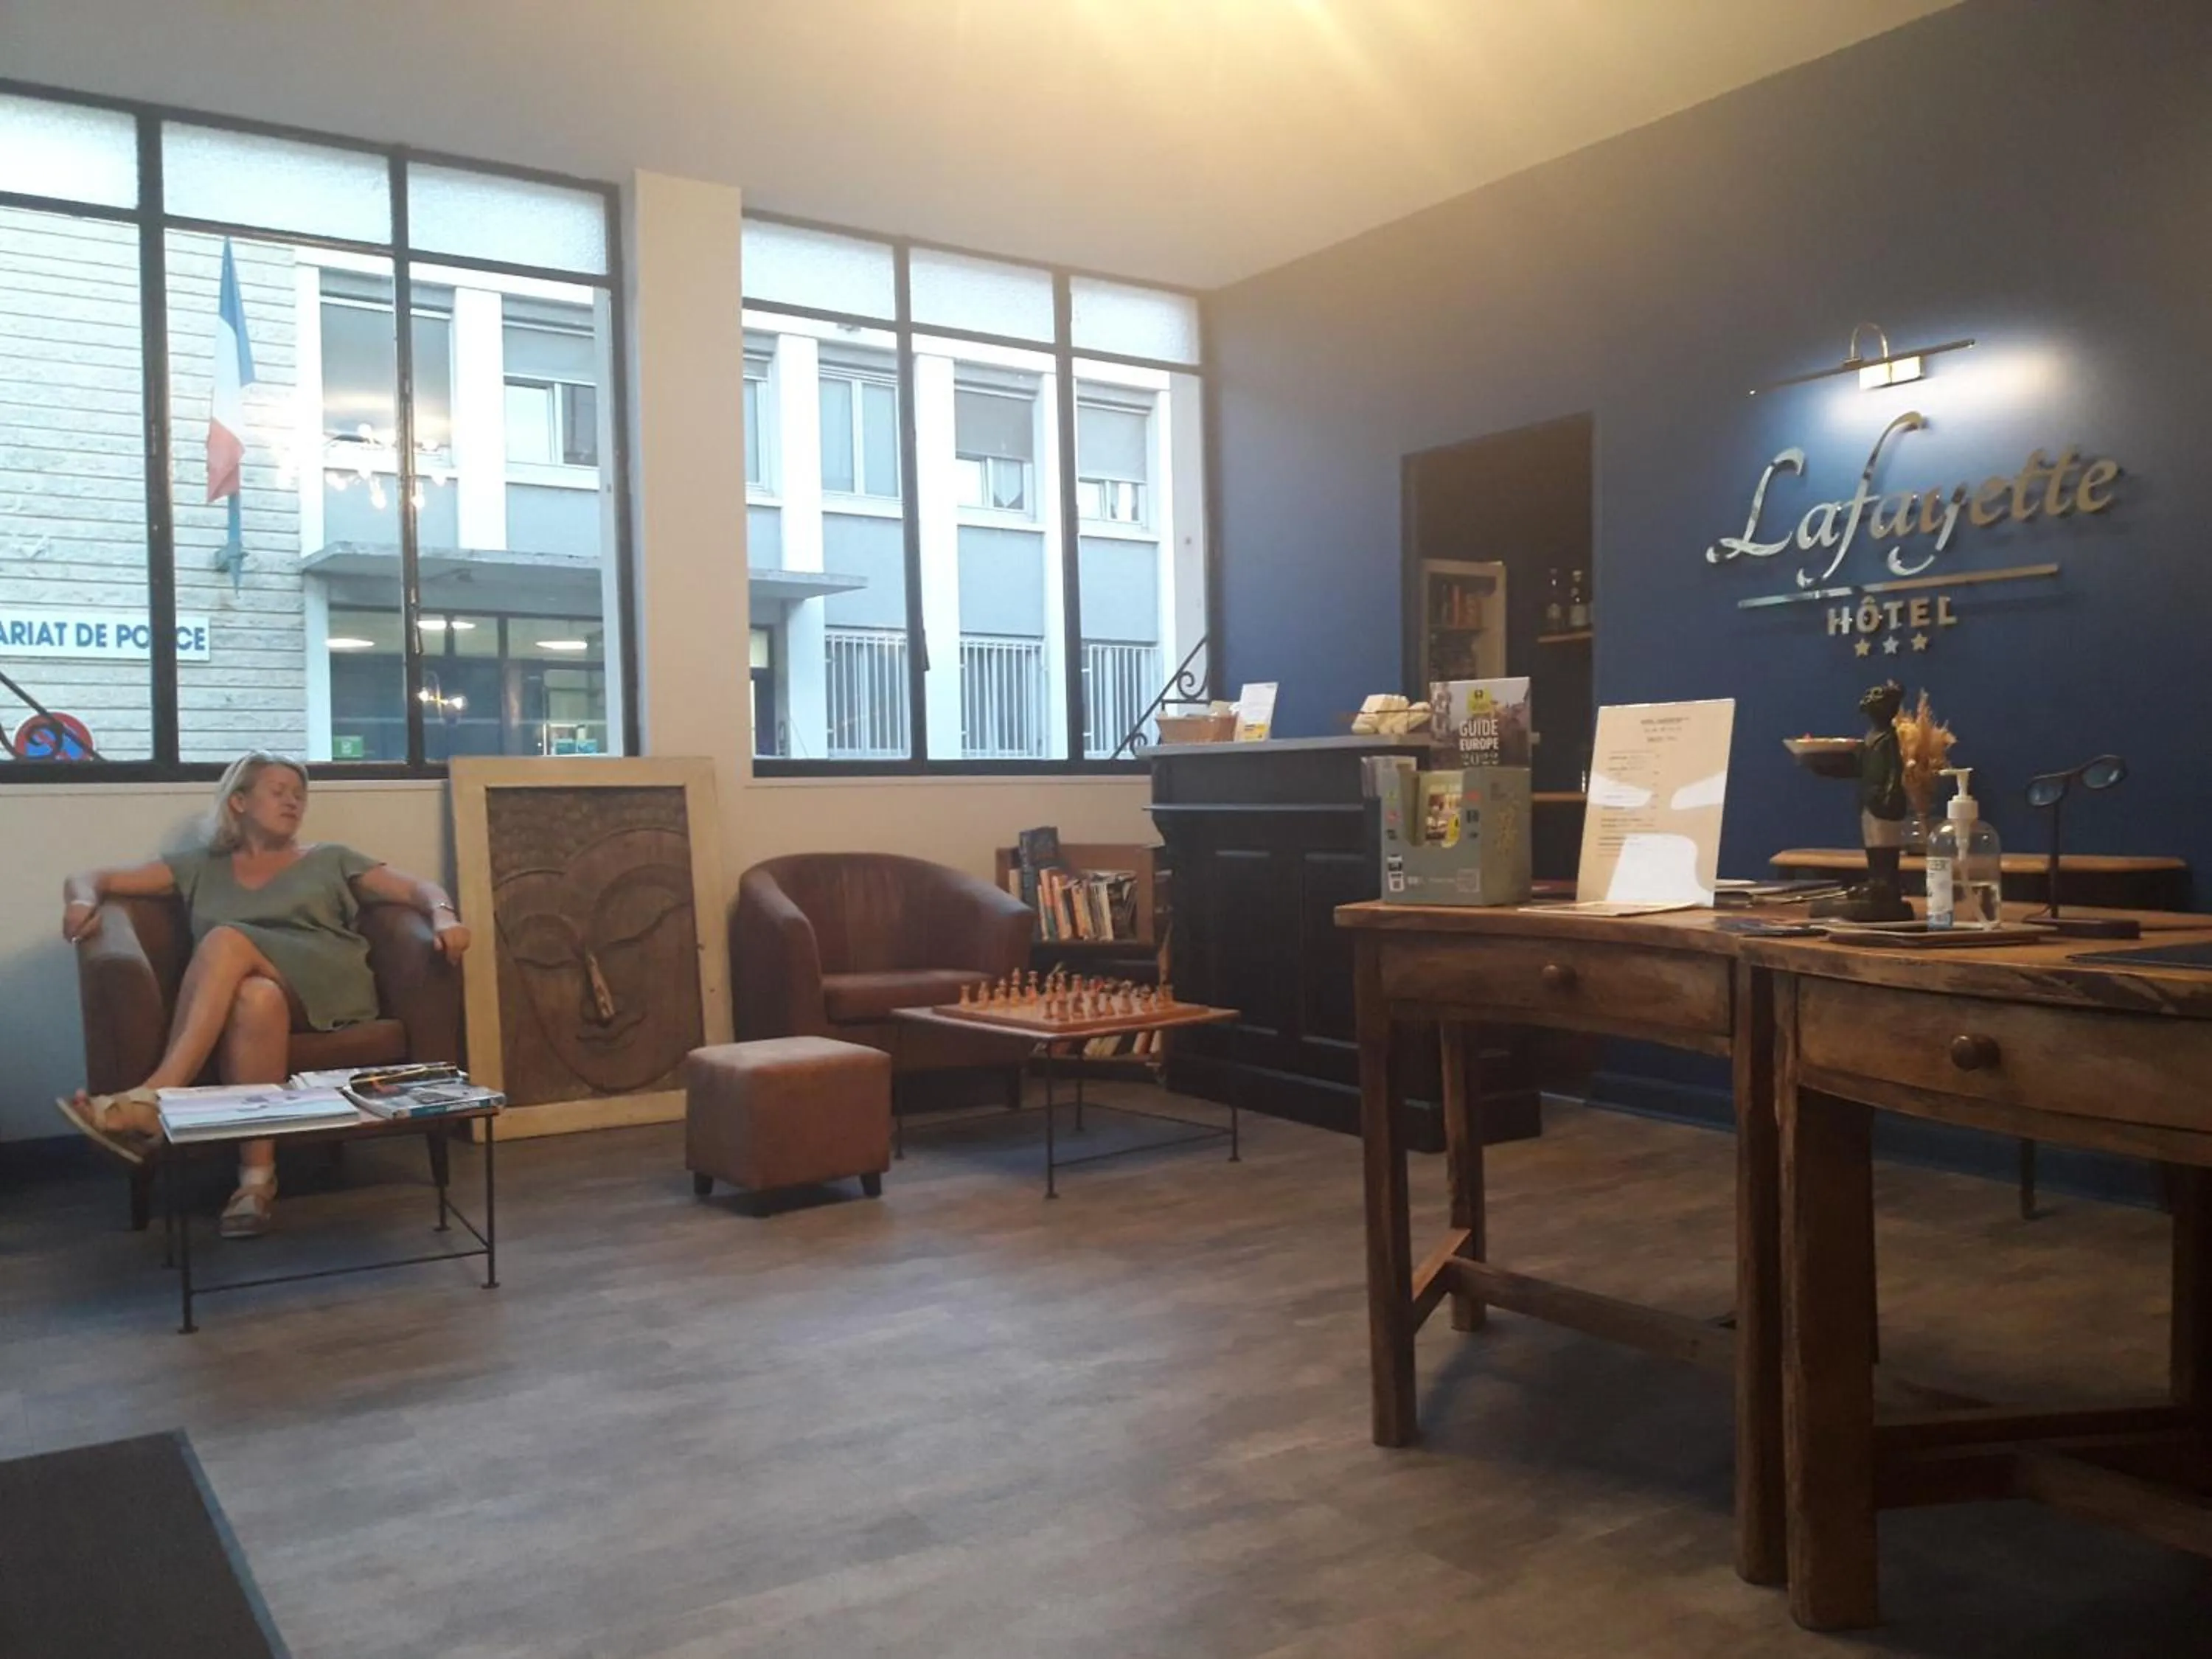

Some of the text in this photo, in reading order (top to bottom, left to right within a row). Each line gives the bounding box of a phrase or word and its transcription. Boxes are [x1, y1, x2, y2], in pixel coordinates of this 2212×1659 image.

[1705, 411, 2118, 588] Lafayette
[1827, 595, 1958, 636] HÔTEL
[76, 623, 107, 647] DE
[116, 624, 206, 650] POCE
[1460, 719, 1499, 737] GUIDE
[1460, 737, 1499, 751] EUROPE
